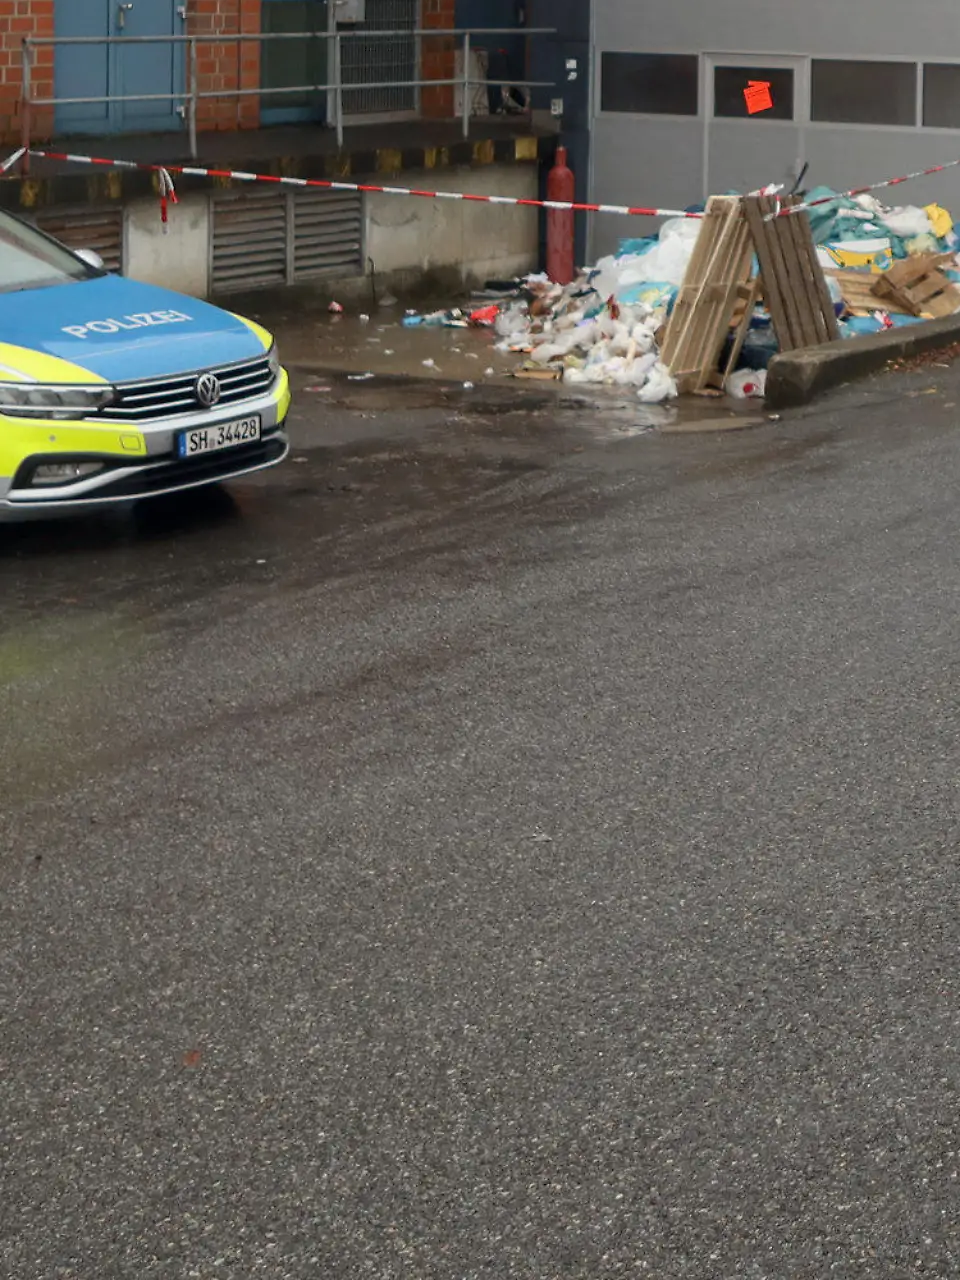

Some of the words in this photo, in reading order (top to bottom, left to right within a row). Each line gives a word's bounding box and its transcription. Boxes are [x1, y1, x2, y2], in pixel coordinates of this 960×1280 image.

[61, 309, 194, 339] POLIZEI
[190, 430, 208, 452] SH
[217, 420, 257, 445] 34428
